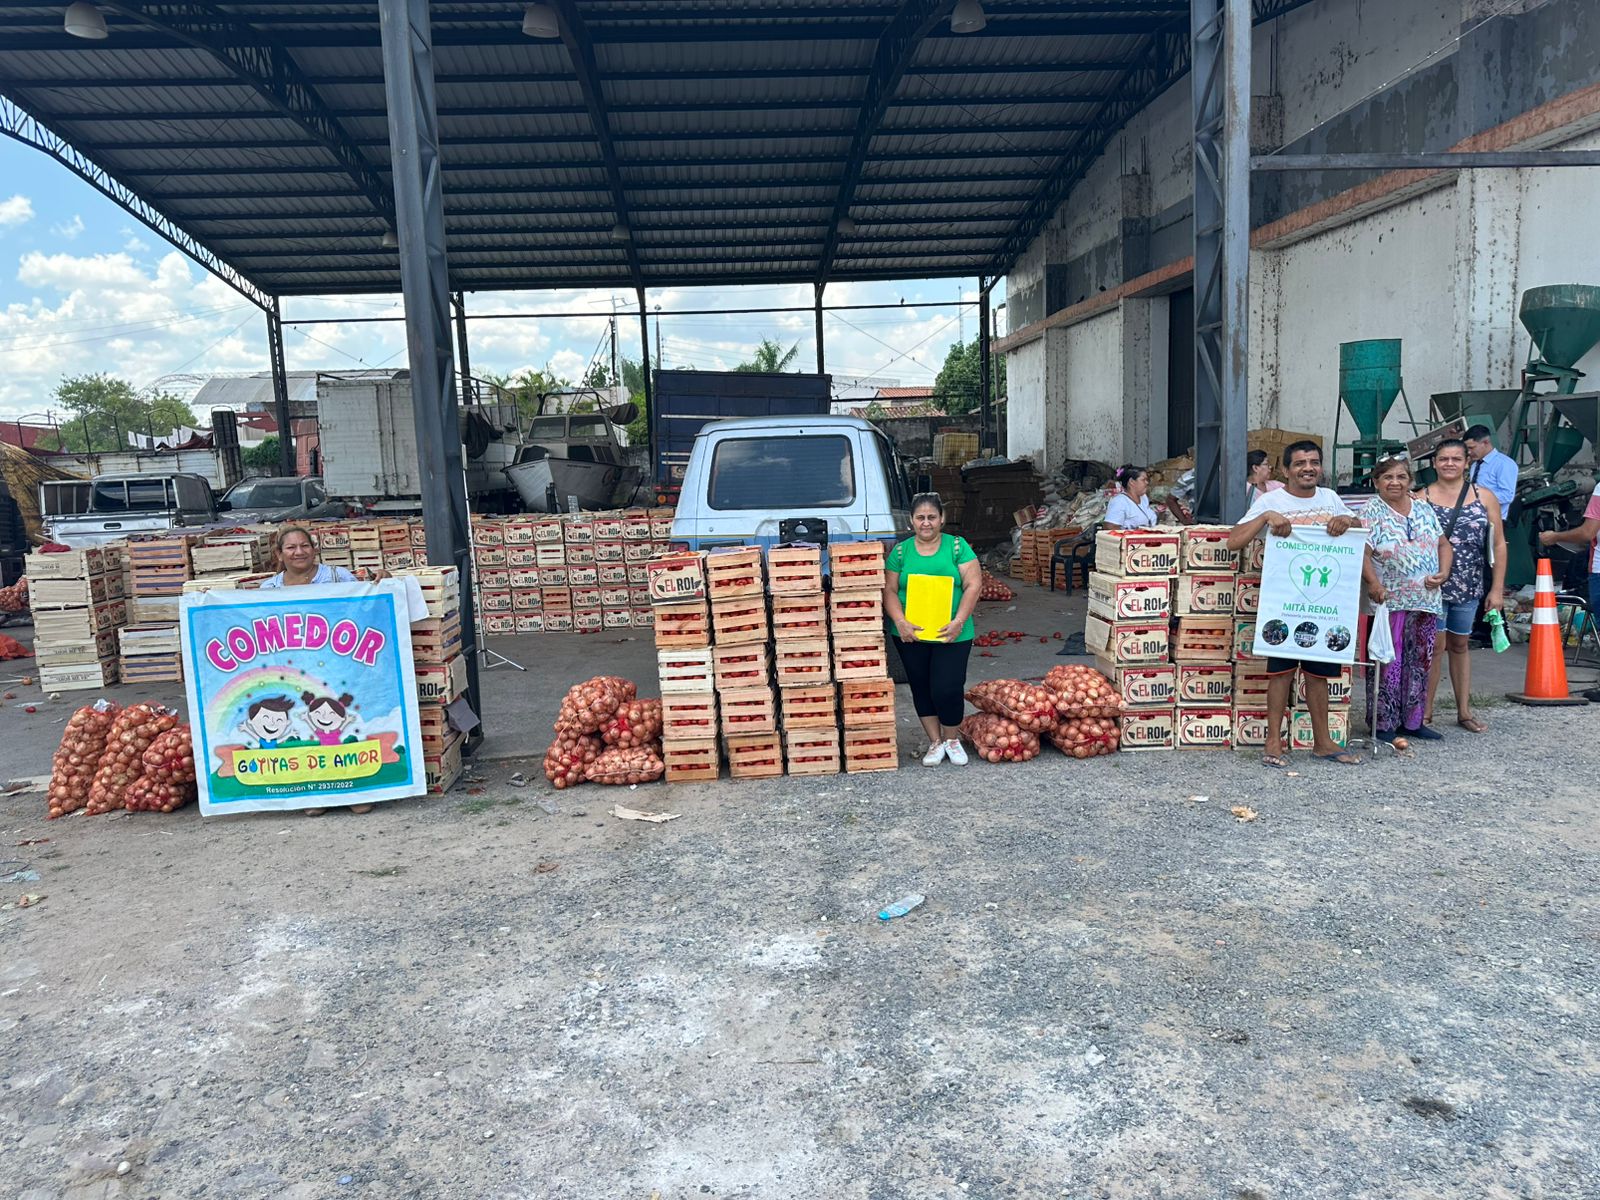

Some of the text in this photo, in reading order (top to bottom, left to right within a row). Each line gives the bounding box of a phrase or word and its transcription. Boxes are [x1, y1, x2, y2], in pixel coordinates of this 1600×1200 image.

[1276, 541, 1355, 554] COMEDOR INFANTIL
[1141, 554, 1169, 567] EL ROI
[1202, 548, 1231, 561] EL ROI
[665, 577, 695, 592] EL ROI
[1131, 598, 1161, 611] EL ROI
[1206, 592, 1231, 605] EL RO
[1308, 605, 1338, 615] RENDÁ
[206, 614, 385, 672] COMEDOR
[1131, 641, 1160, 654] EL ROI
[420, 683, 437, 696] ROI
[1139, 683, 1167, 696] EL ROI
[1196, 682, 1224, 694] EL ROI
[1136, 727, 1164, 739] EL ROI
[1195, 726, 1223, 738] EL ROI
[1252, 726, 1262, 738] EL
[238, 751, 378, 774] GOTITAS DE AMOR
[318, 781, 354, 790] 2937/2022
